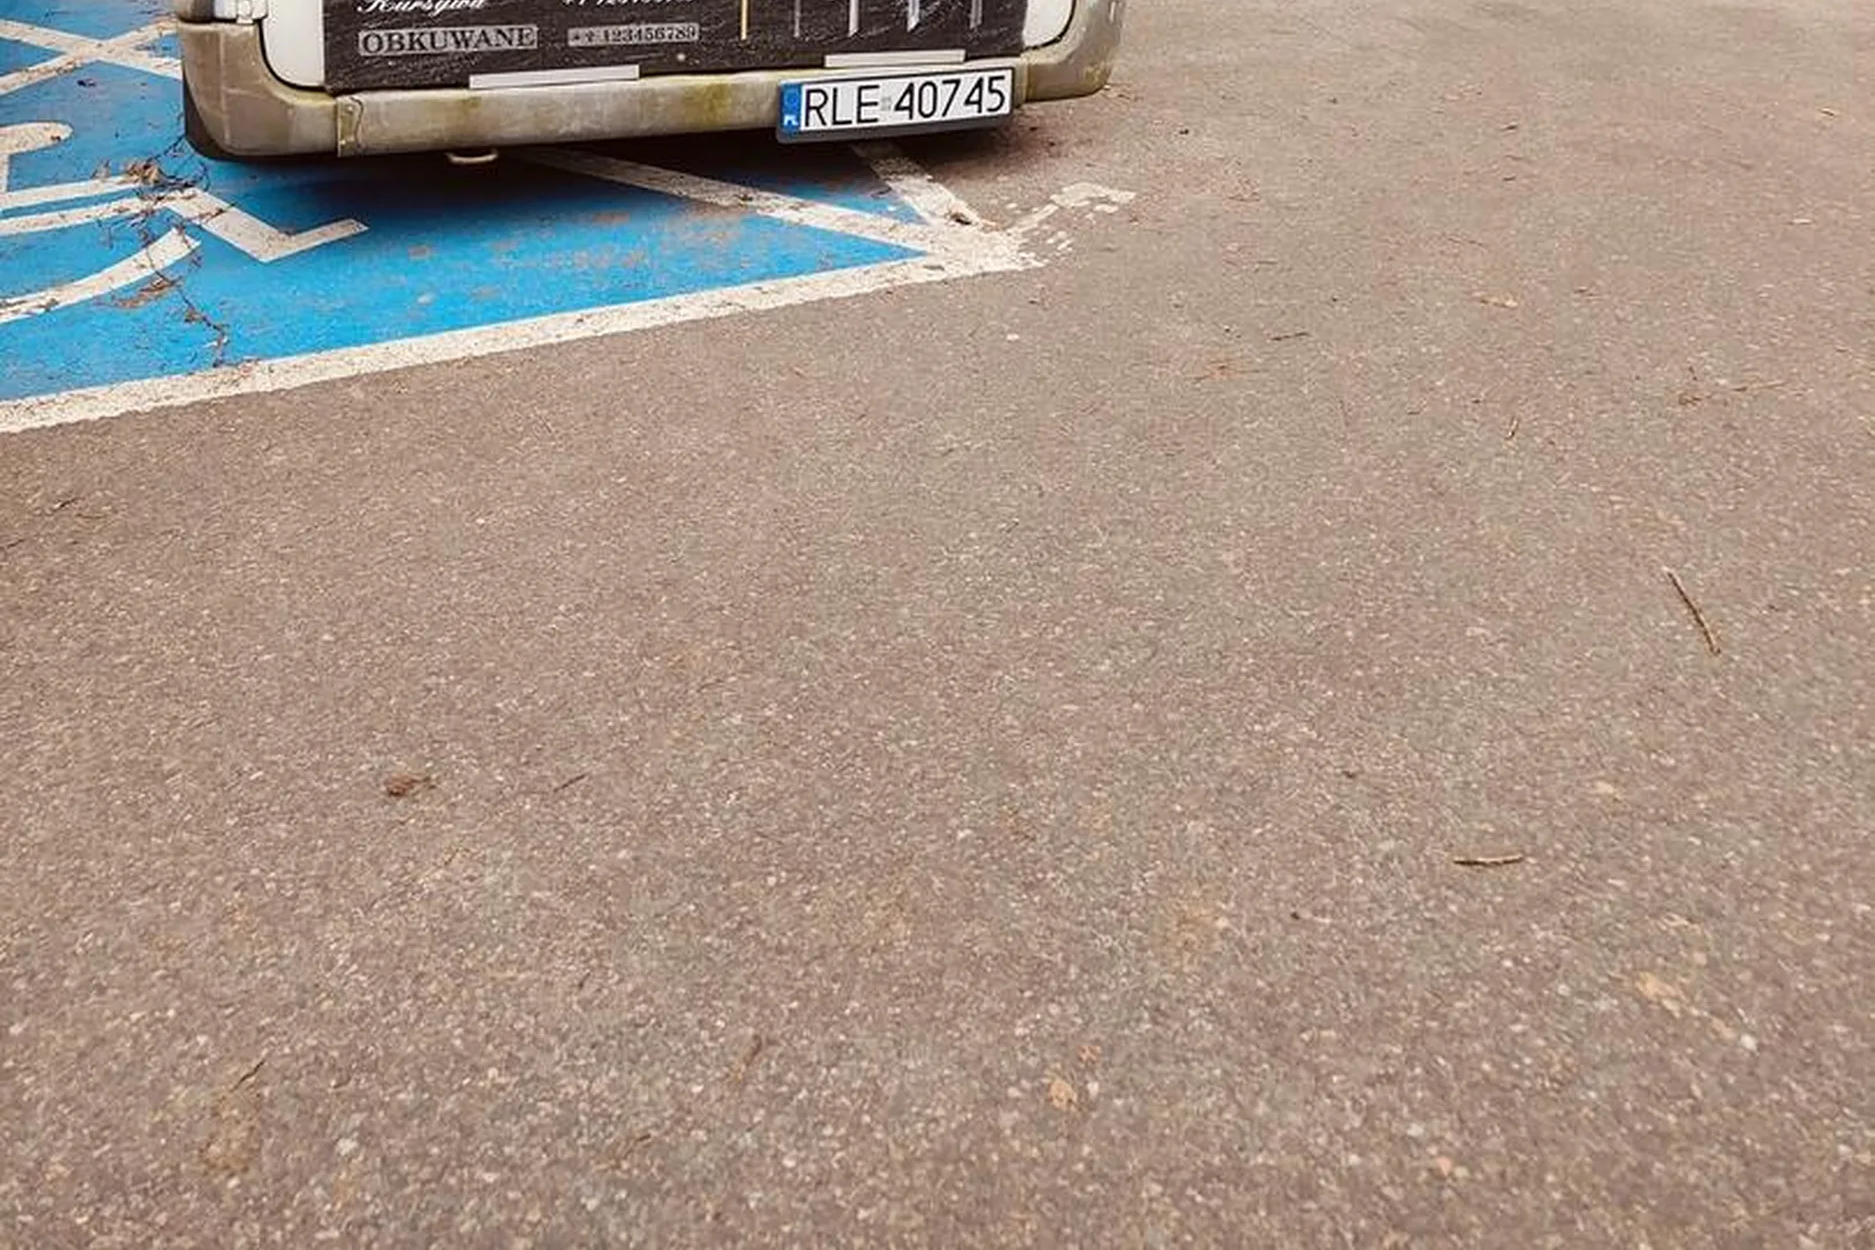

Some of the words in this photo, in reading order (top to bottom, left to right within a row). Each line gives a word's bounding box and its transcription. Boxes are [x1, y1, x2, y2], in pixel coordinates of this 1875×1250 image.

[361, 27, 536, 54] OBKUWANE
[602, 26, 696, 44] 123456789
[804, 84, 881, 127] RLE
[894, 75, 1006, 120] 40745
